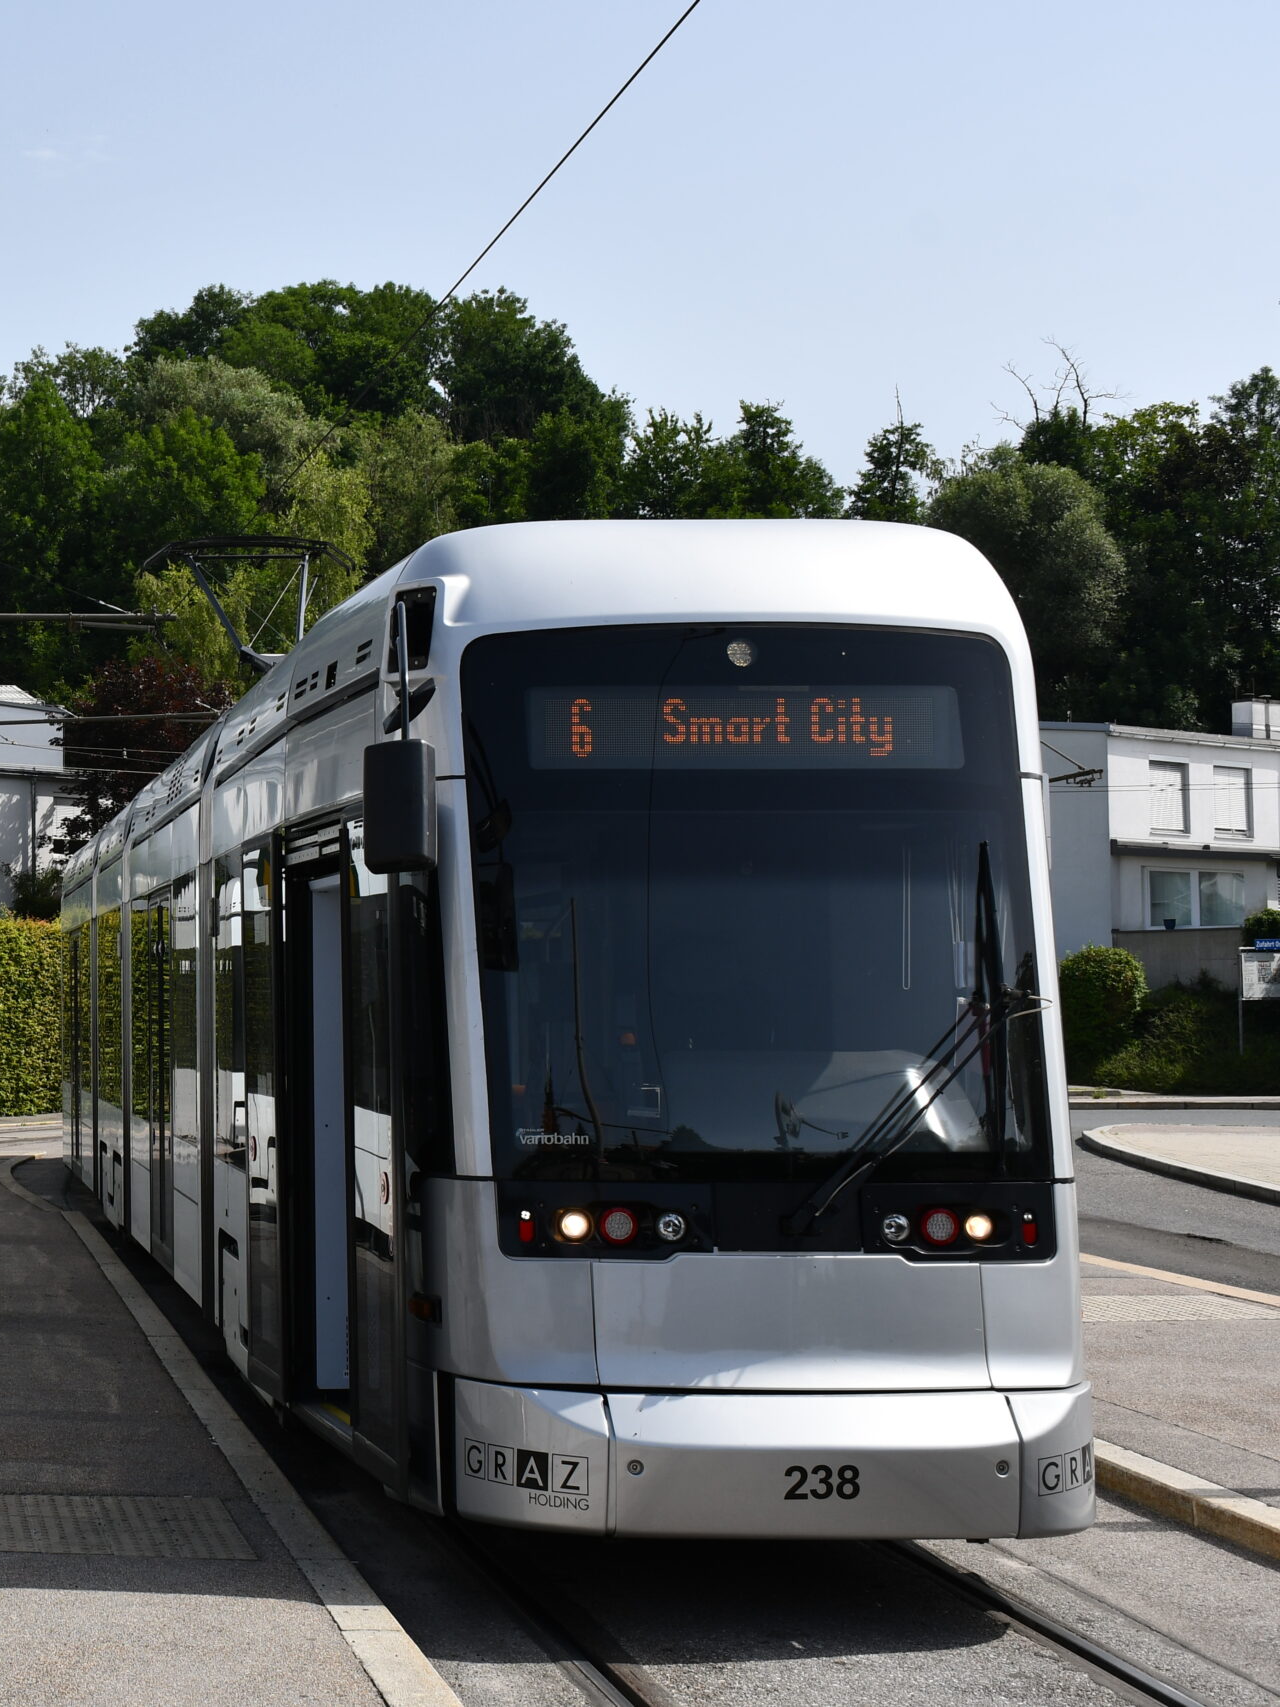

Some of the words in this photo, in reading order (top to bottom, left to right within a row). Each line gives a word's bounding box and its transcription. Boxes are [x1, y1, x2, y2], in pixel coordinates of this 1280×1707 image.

[572, 699, 592, 757] 6
[663, 698, 790, 743] Smart
[811, 698, 893, 756] City
[519, 1132, 590, 1145] variobahn
[466, 1443, 583, 1491] GRAZ
[783, 1464, 861, 1501] 238
[1040, 1446, 1093, 1491] GRA
[528, 1492, 590, 1511] HOLDING
